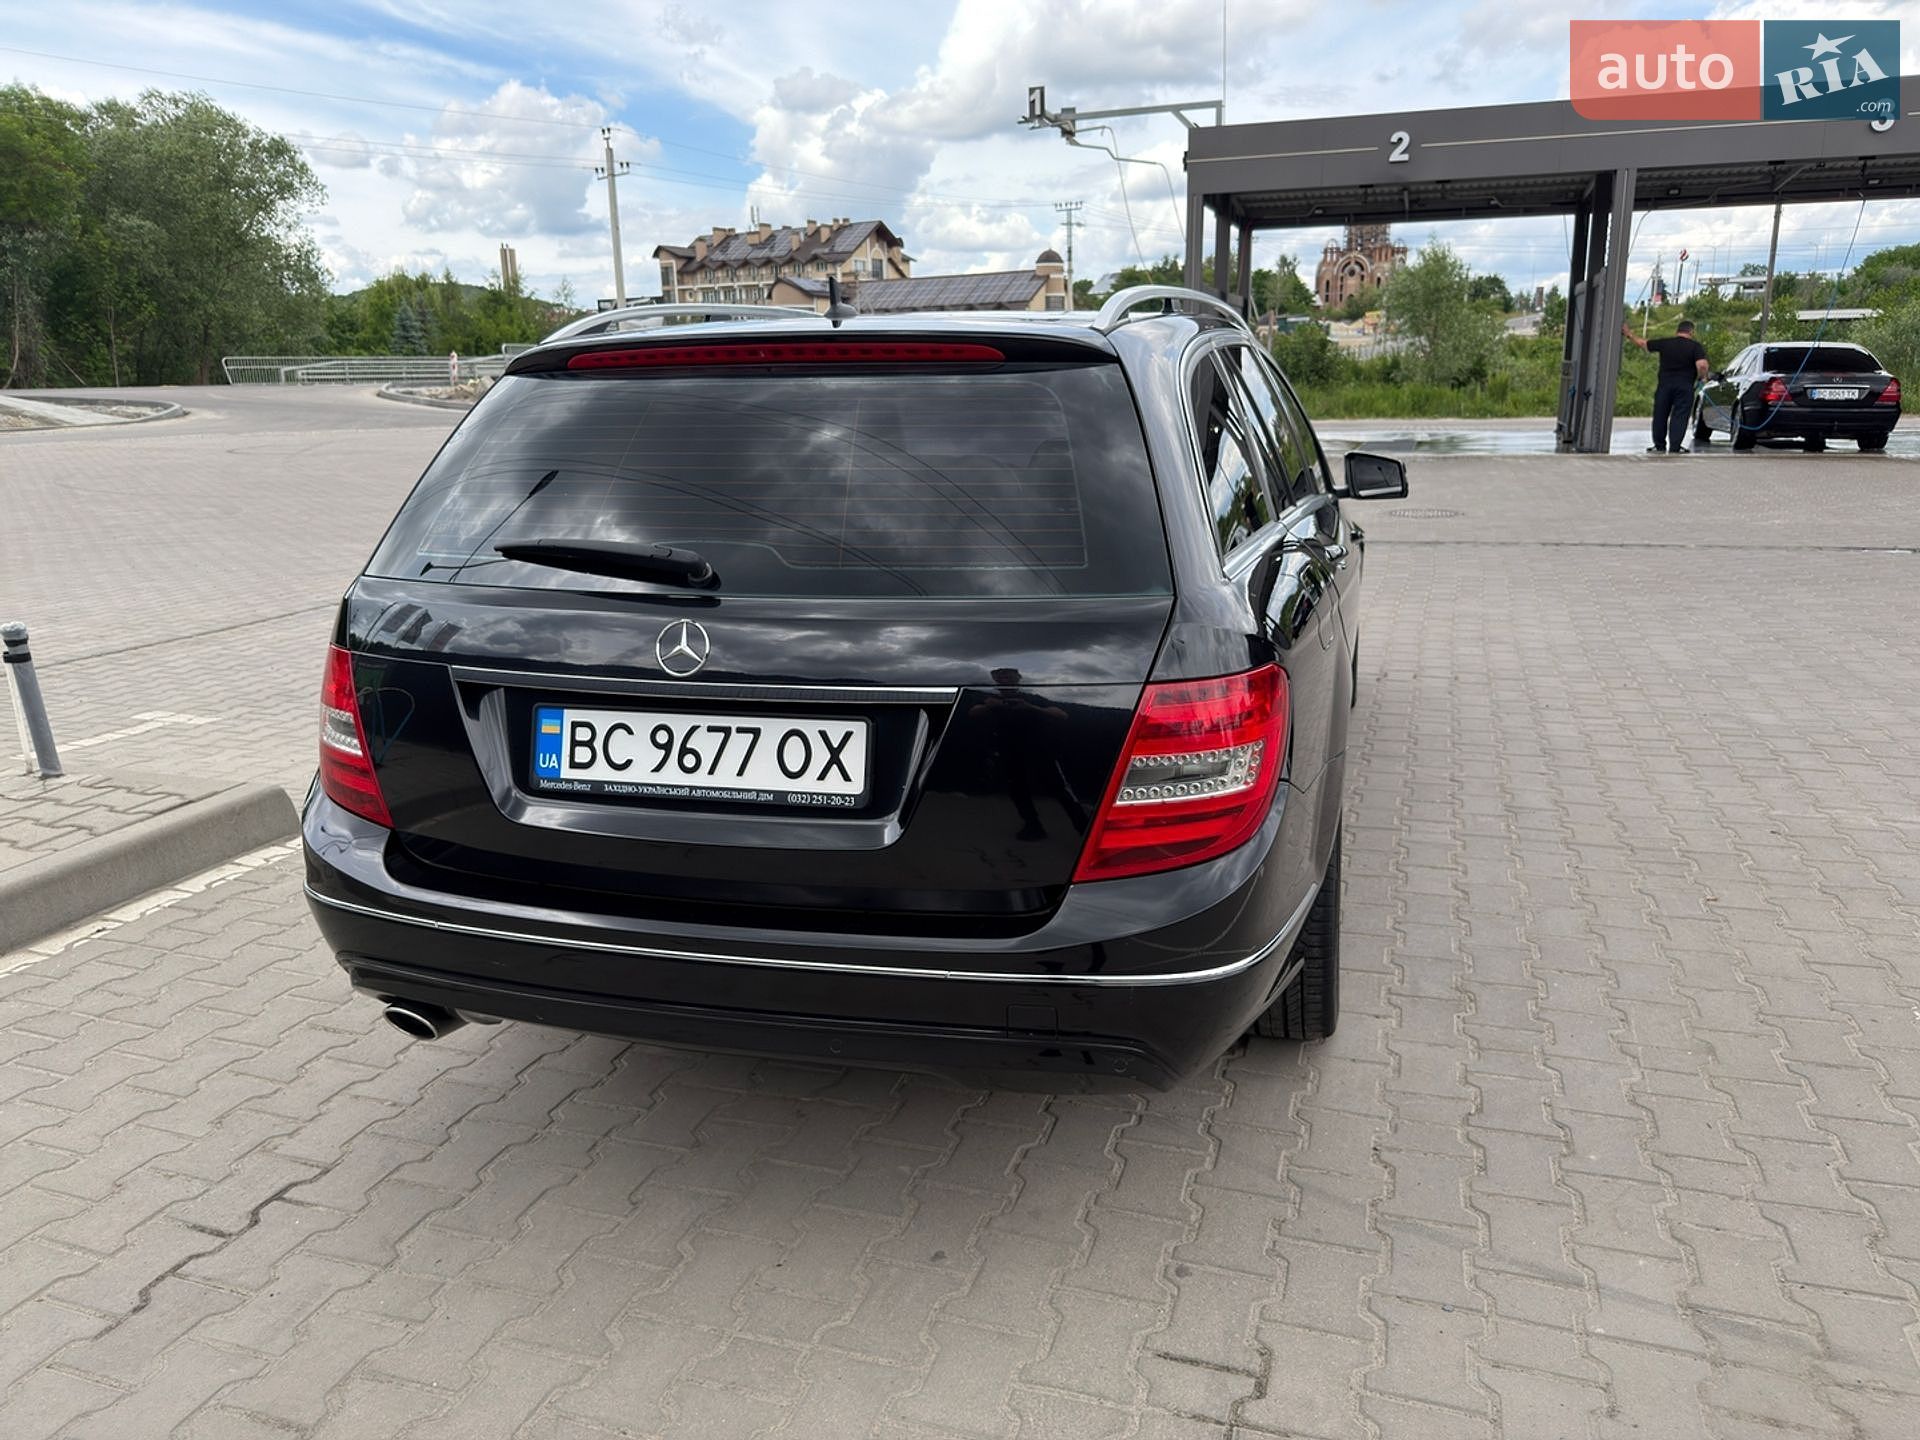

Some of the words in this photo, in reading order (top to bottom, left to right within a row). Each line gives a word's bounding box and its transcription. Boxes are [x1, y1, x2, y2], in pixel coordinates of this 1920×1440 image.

[1030, 89, 1041, 115] 1
[1389, 131, 1410, 162] 2
[539, 753, 558, 769] UA
[569, 721, 634, 771] BC
[650, 723, 761, 776] 9677
[776, 728, 854, 782] OX
[691, 789, 757, 800] АВТОМОБІЛЬНИЙ
[787, 793, 810, 805] (032)
[812, 794, 855, 807] 251-20-23
